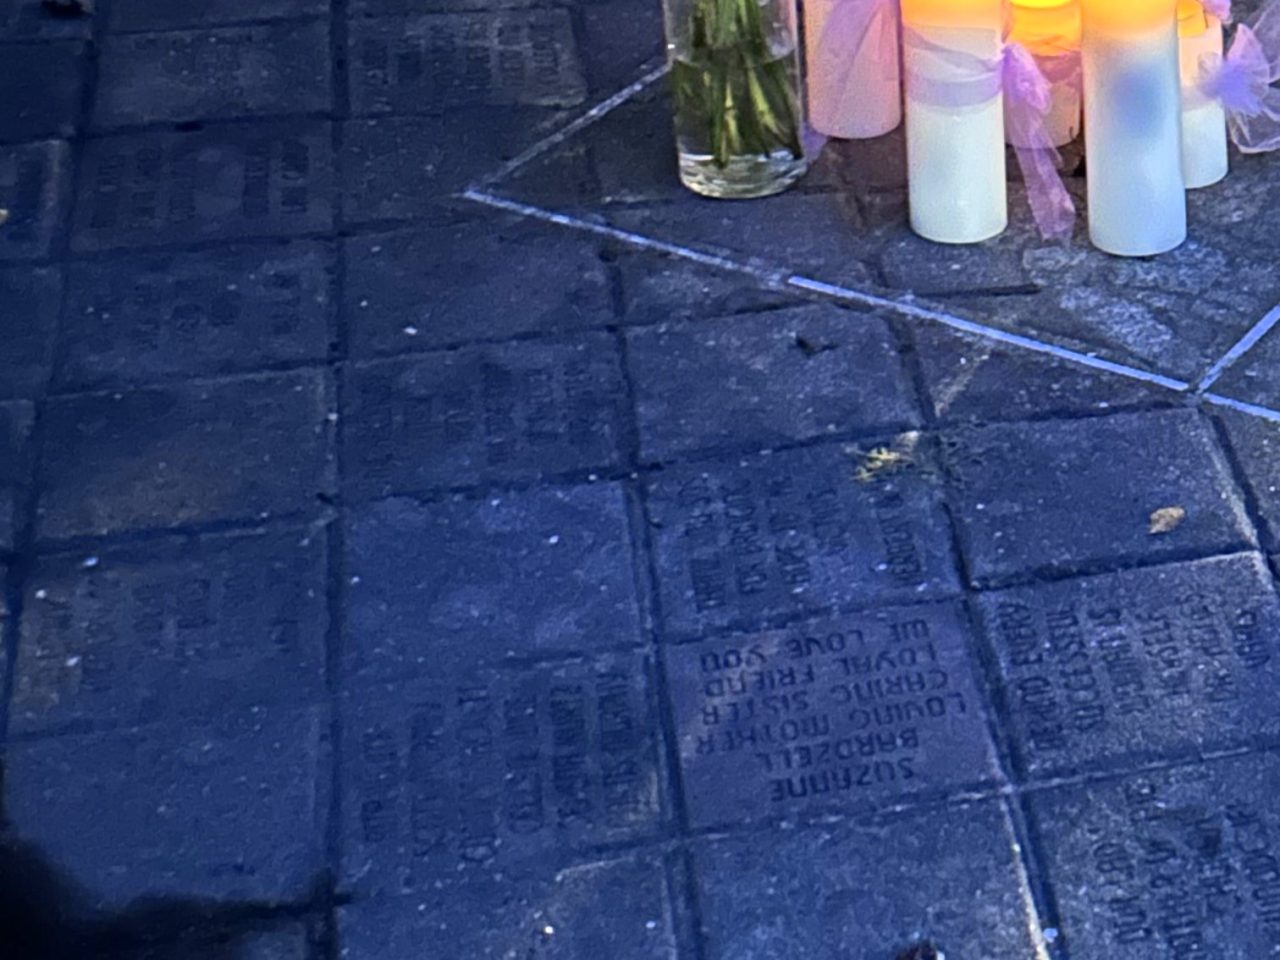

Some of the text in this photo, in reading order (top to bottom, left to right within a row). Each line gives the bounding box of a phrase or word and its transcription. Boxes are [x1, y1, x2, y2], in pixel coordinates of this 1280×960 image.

[698, 617, 930, 673] WE LOVE YOU
[701, 642, 937, 699] LOYAL FRIEND
[693, 691, 967, 755] LOVING MOTHER
[699, 667, 949, 726] CARING SISTER
[754, 726, 919, 774] BARDZELL
[767, 755, 917, 802] SUZANNE
